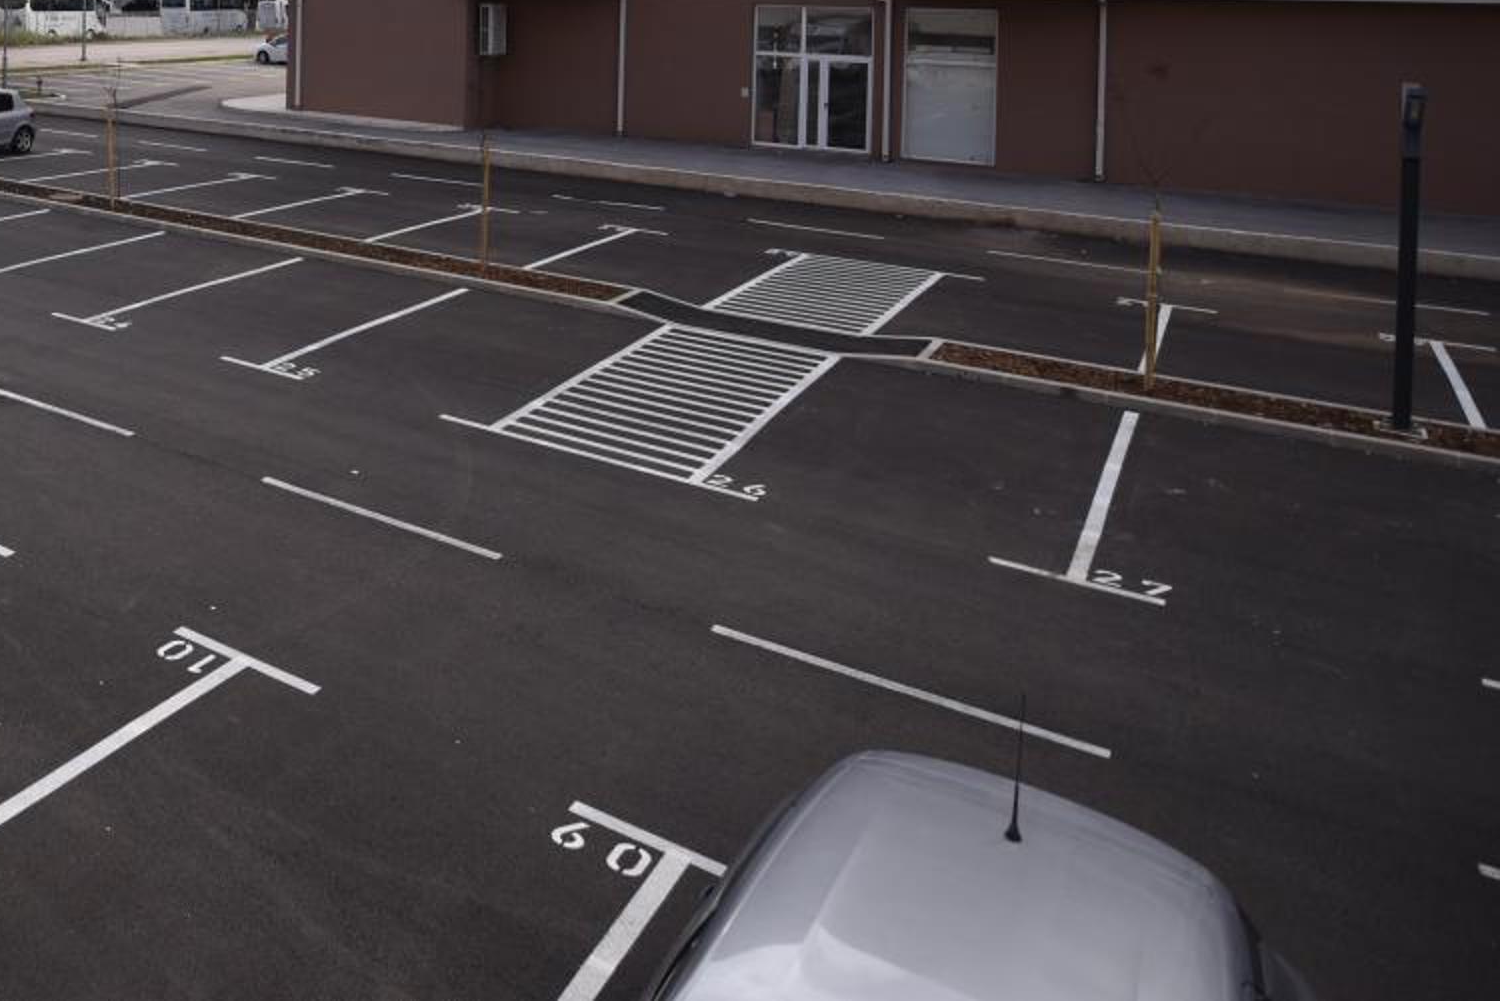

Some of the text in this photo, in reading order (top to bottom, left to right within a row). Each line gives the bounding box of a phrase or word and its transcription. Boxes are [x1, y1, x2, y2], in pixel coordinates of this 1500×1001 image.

[706, 474, 767, 496] 26
[1092, 569, 1173, 596] 27
[156, 640, 217, 674] 10
